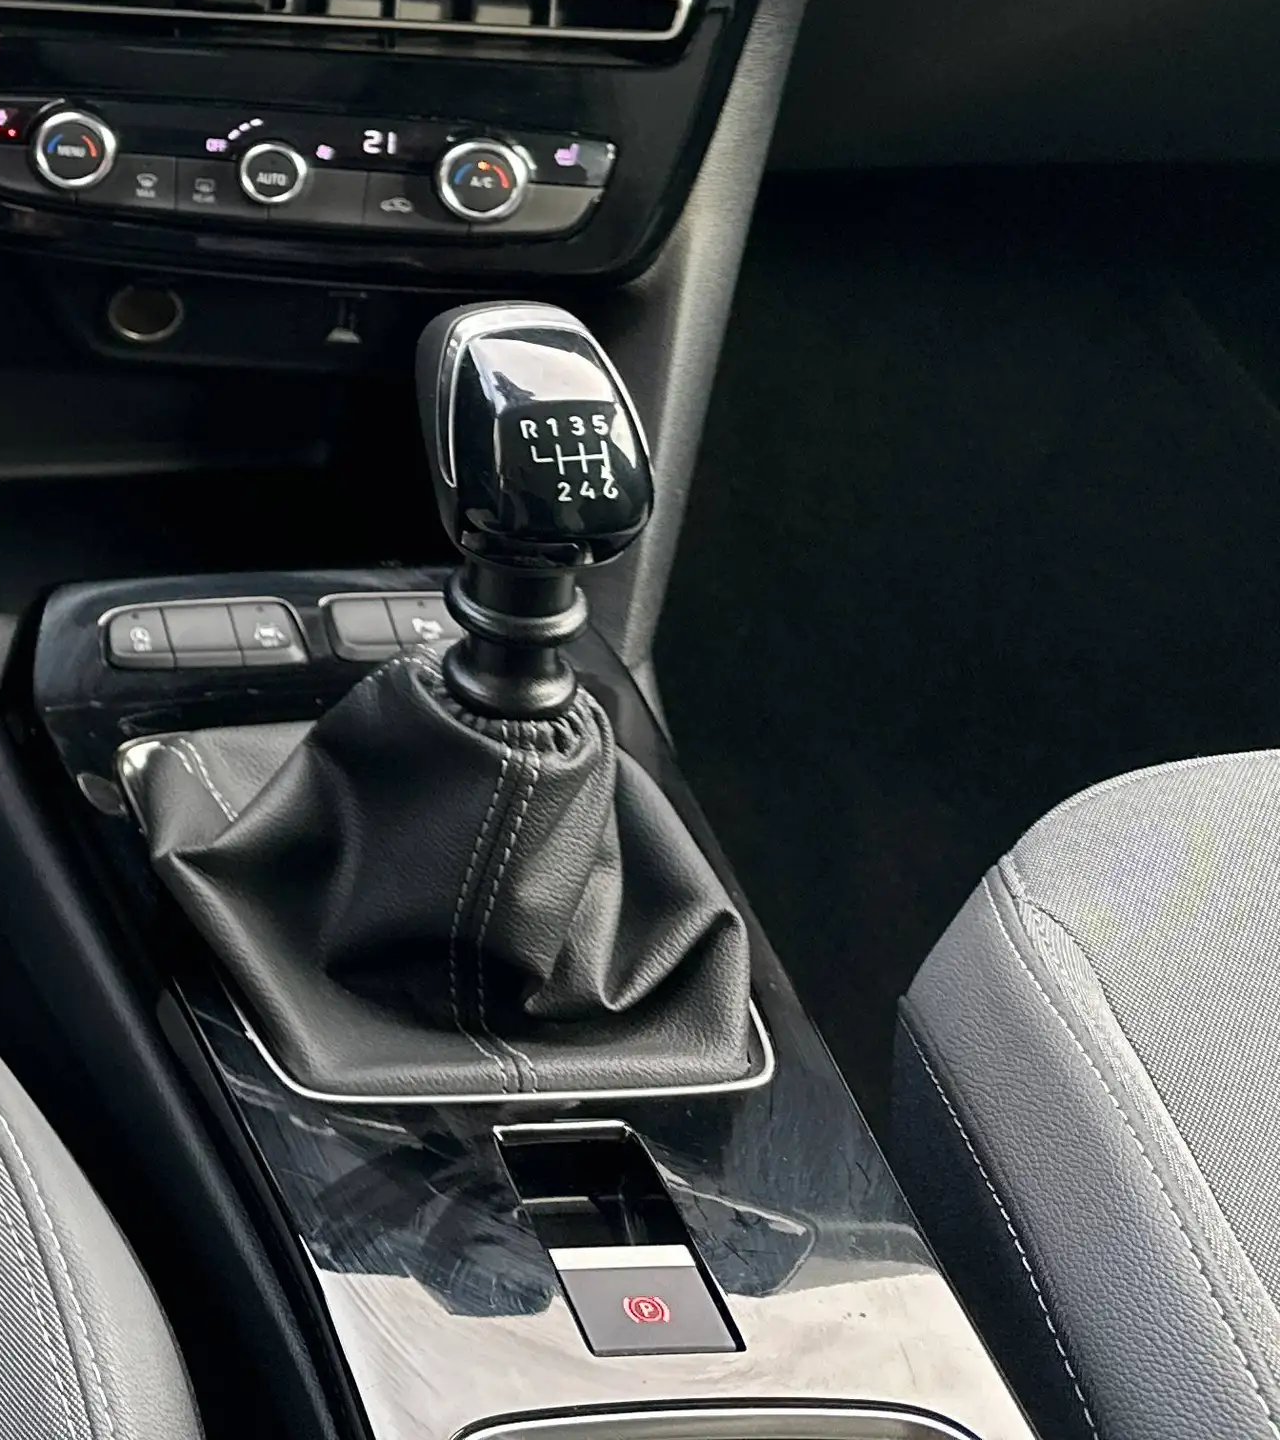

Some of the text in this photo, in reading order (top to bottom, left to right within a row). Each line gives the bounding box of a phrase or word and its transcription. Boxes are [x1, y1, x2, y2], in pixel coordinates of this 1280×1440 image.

[362, 130, 397, 154] 21
[257, 172, 286, 186] AUTO
[520, 415, 609, 439] R 1 3 5
[557, 476, 619, 502] 2 4 6
